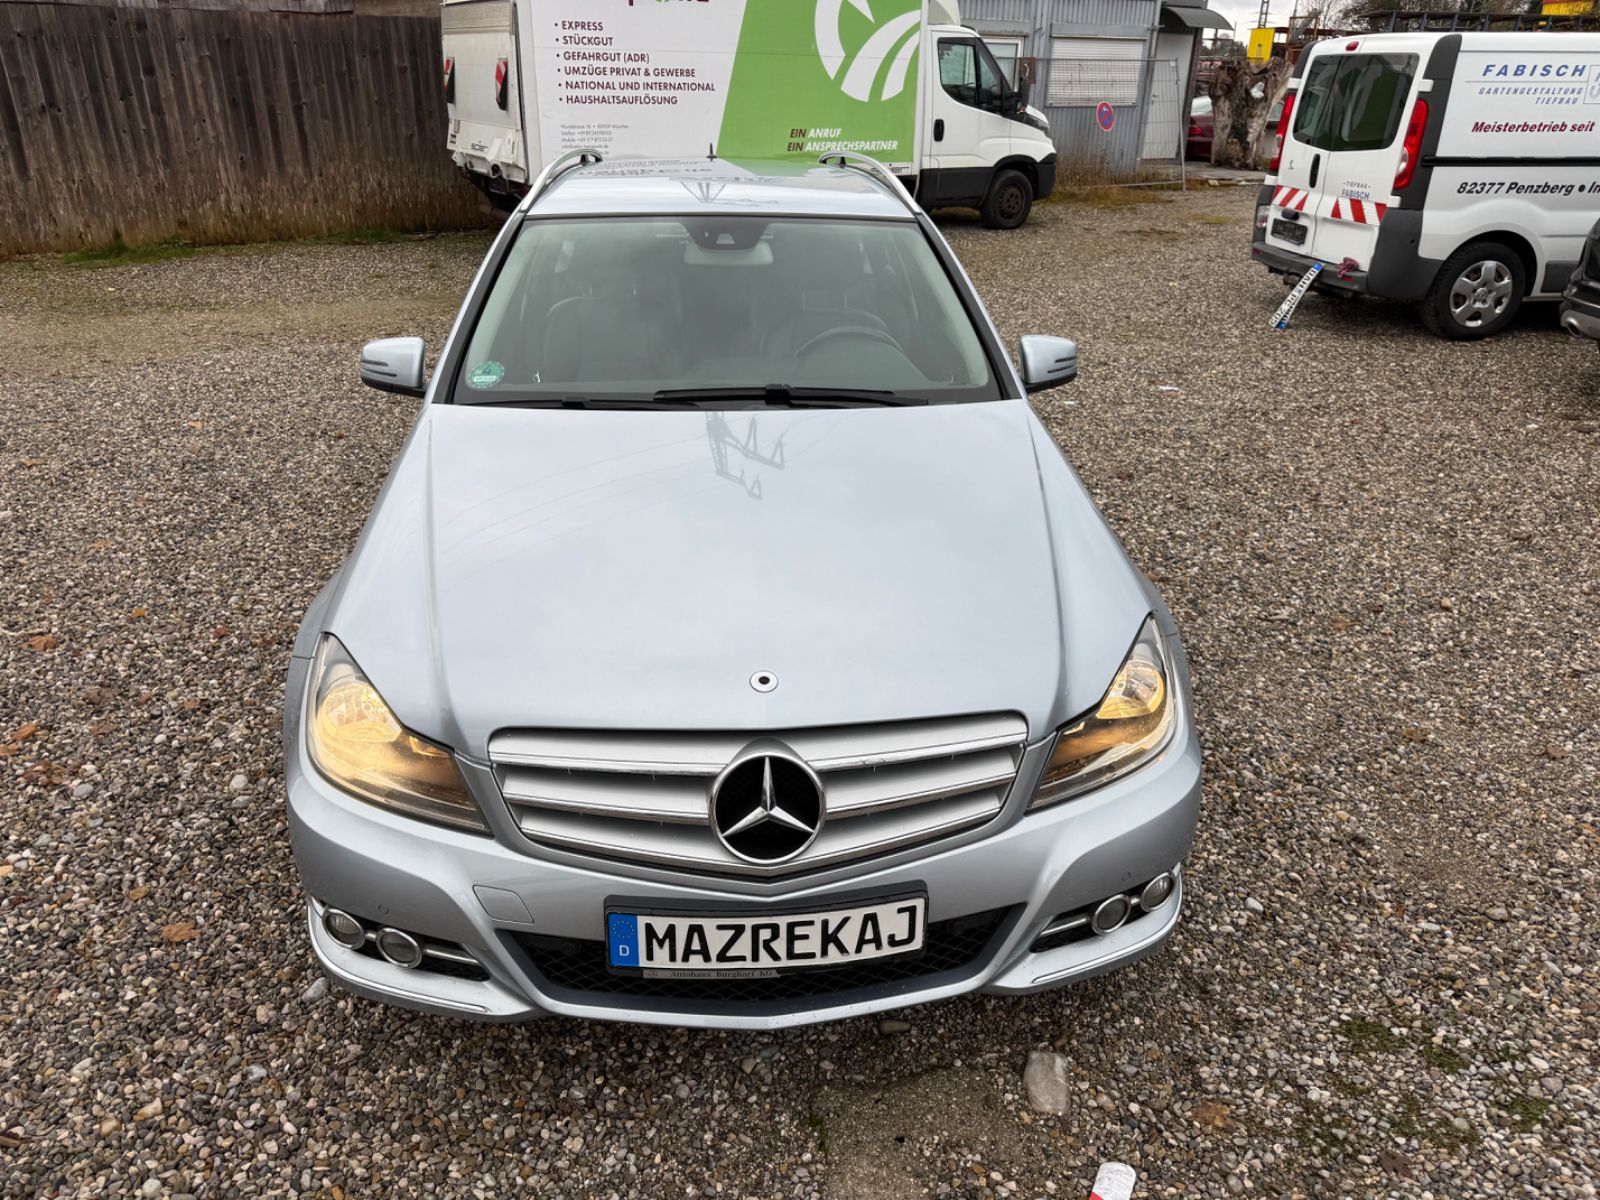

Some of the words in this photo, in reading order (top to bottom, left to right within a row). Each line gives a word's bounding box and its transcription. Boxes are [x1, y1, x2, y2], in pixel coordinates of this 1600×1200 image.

[562, 20, 604, 31] EXPRESS
[562, 34, 613, 46] STÜCKGUT
[564, 51, 621, 62] GEFAHRGUT
[624, 53, 650, 64] (ADR)
[564, 64, 608, 76] UMZÜGE
[610, 67, 642, 77] PRIVAT
[644, 68, 650, 77] &
[653, 68, 695, 77] GEWERBE
[1482, 64, 1586, 77] FABISCH
[566, 81, 616, 91] NATIONAL
[618, 82, 640, 91] UND
[643, 82, 715, 92] INTERNATIONAL
[566, 93, 678, 105] HAUSHALTSAUFLÖSUNG
[1471, 121, 1568, 132] Meisterbetrieb
[1570, 121, 1595, 132] seit
[790, 128, 807, 138] EIN
[808, 128, 842, 138] ANRUF
[787, 142, 804, 152] EIN
[805, 141, 898, 152] ANSPRECHSPARTNER
[1457, 182, 1505, 194] 82377
[1505, 181, 1575, 196] Penzberg
[644, 904, 917, 963] MAZREKAJ
[619, 945, 630, 956] D
